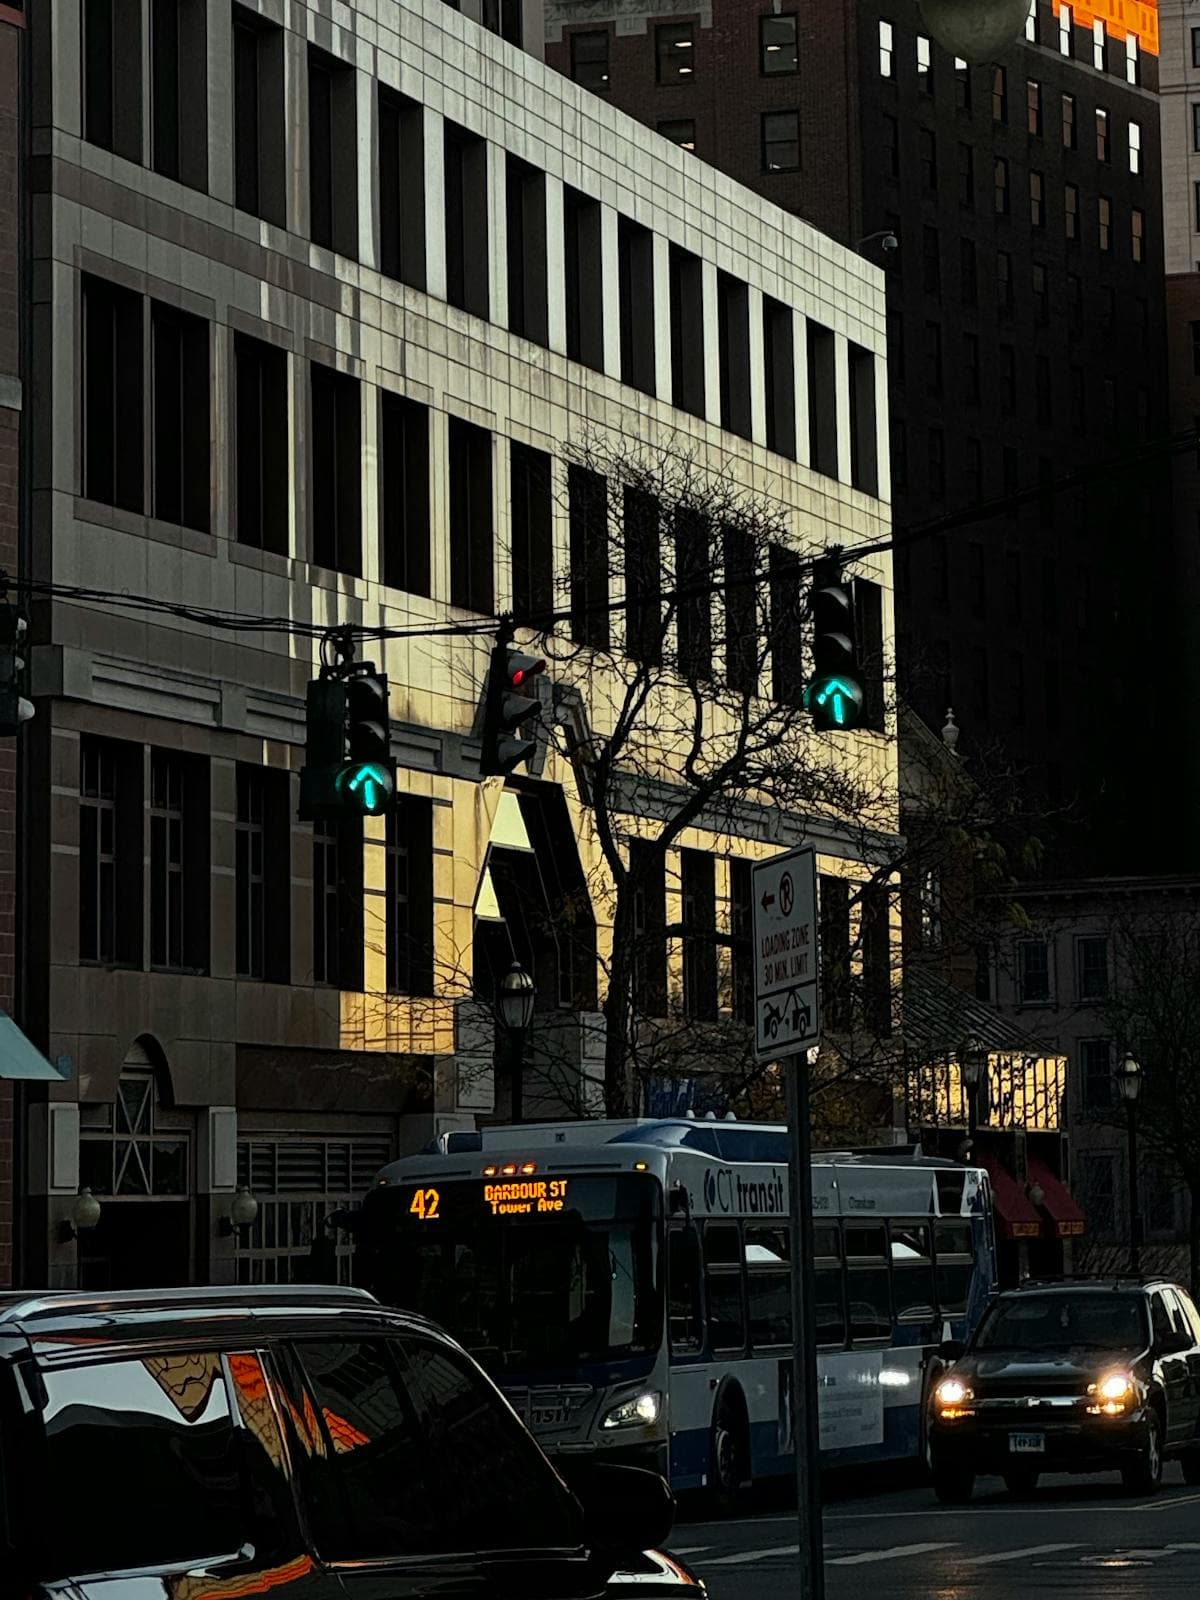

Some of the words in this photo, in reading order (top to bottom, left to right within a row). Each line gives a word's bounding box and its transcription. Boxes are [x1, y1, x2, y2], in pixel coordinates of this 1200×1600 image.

[761, 930, 790, 959] LOADING
[791, 924, 810, 949] ZONE
[763, 963, 774, 986] 30
[774, 959, 789, 981] MIN.
[790, 952, 809, 978] LIMIT
[409, 1188, 440, 1220] 42
[484, 1182, 547, 1202] BARBOUR
[549, 1180, 568, 1198] ST
[490, 1199, 533, 1216] Tower
[537, 1198, 564, 1212] Ave
